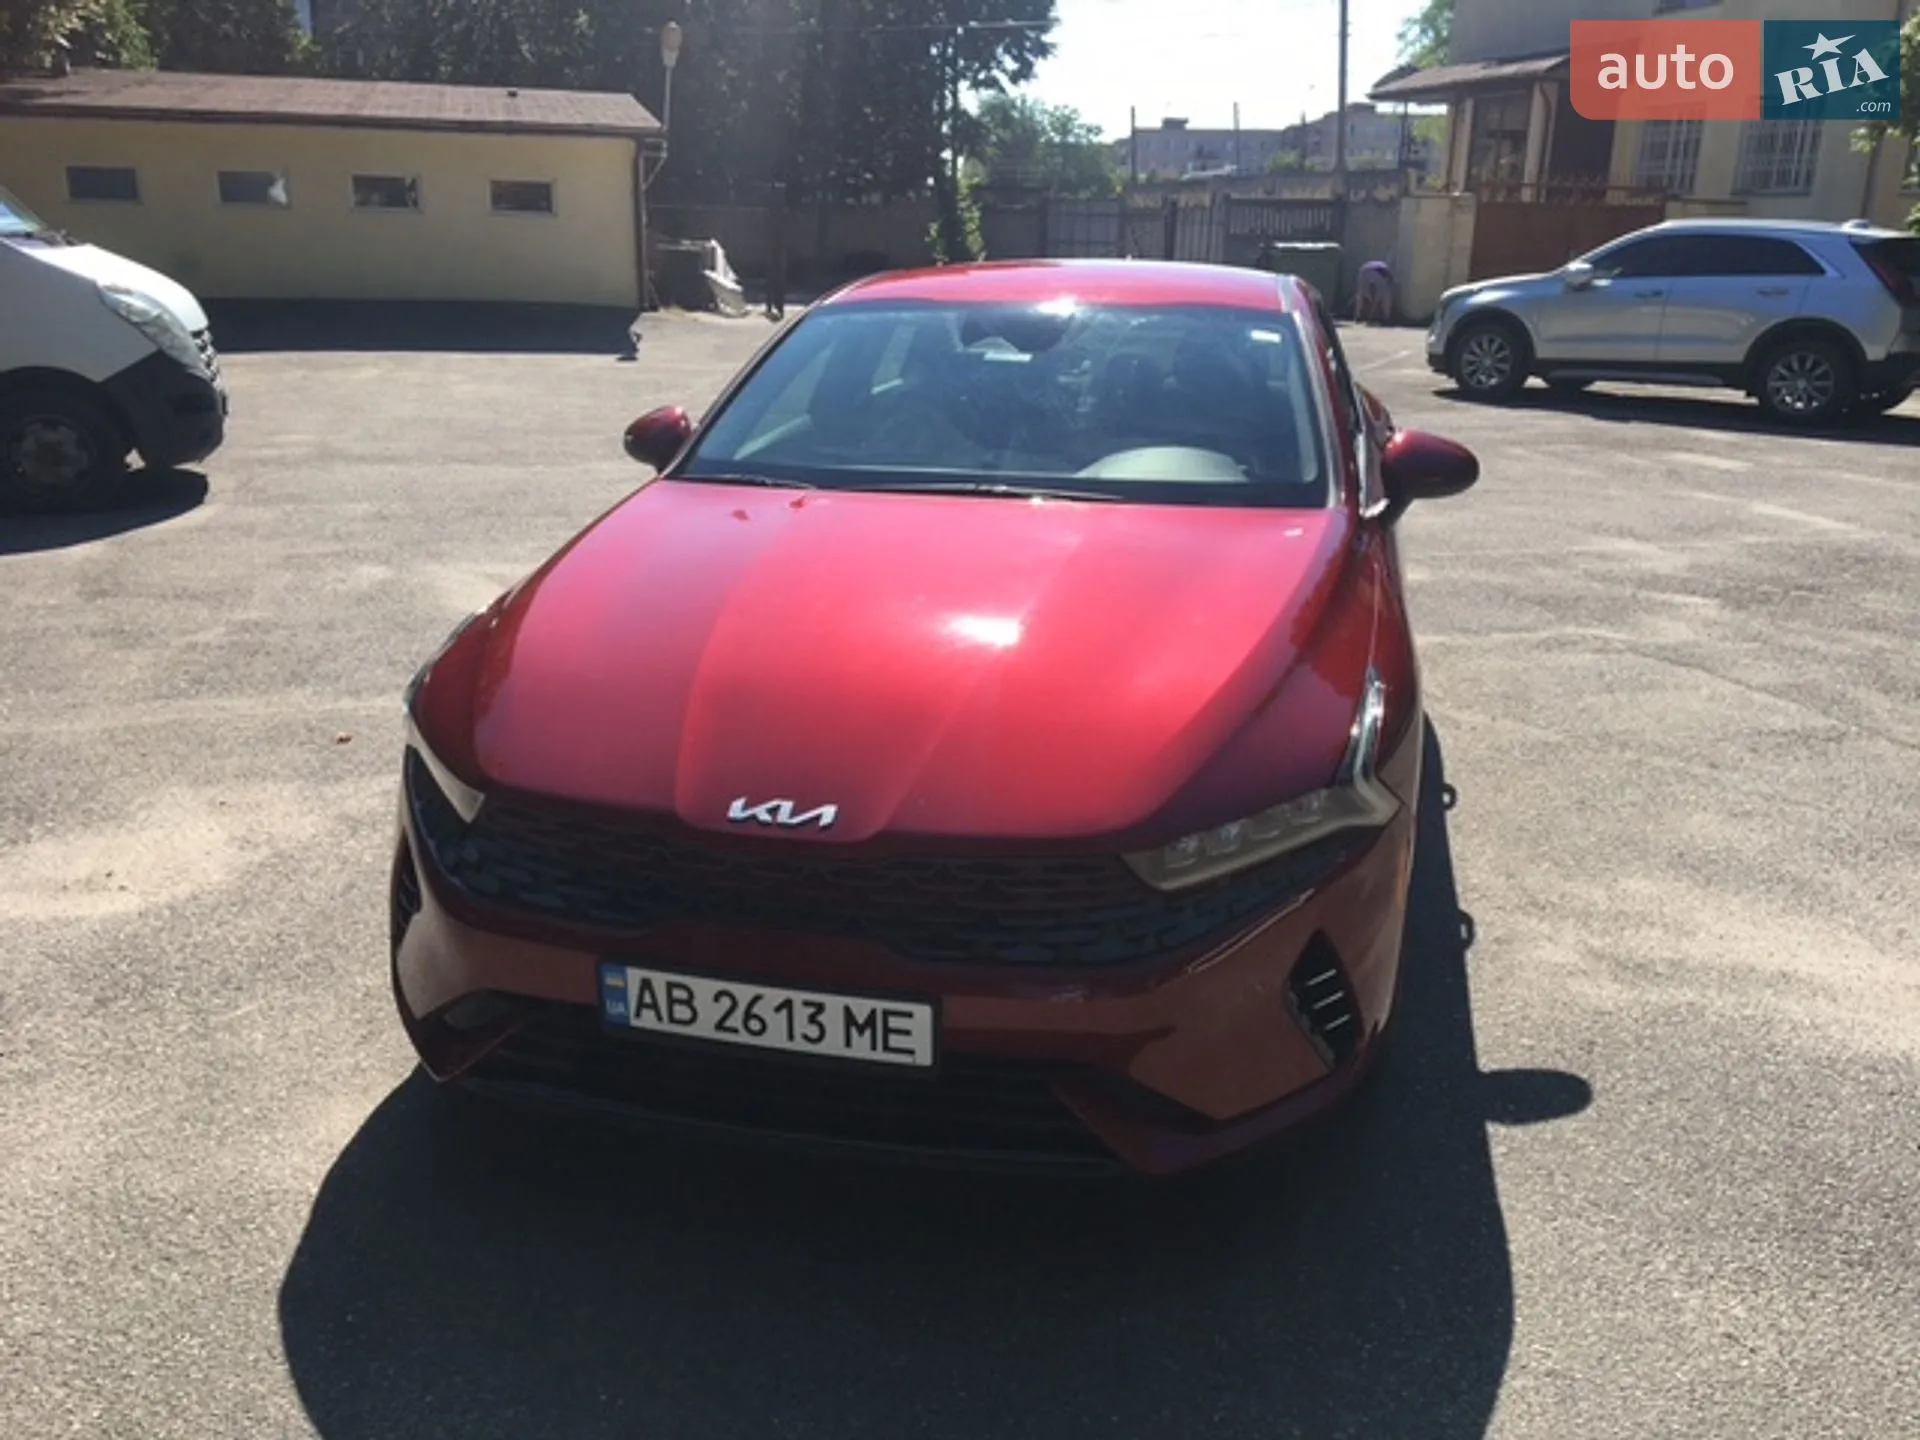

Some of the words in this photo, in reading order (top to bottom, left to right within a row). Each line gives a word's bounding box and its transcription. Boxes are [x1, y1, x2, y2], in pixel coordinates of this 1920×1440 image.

[634, 976, 698, 1026] AB
[713, 989, 826, 1045] 2613
[843, 1004, 915, 1055] ME
